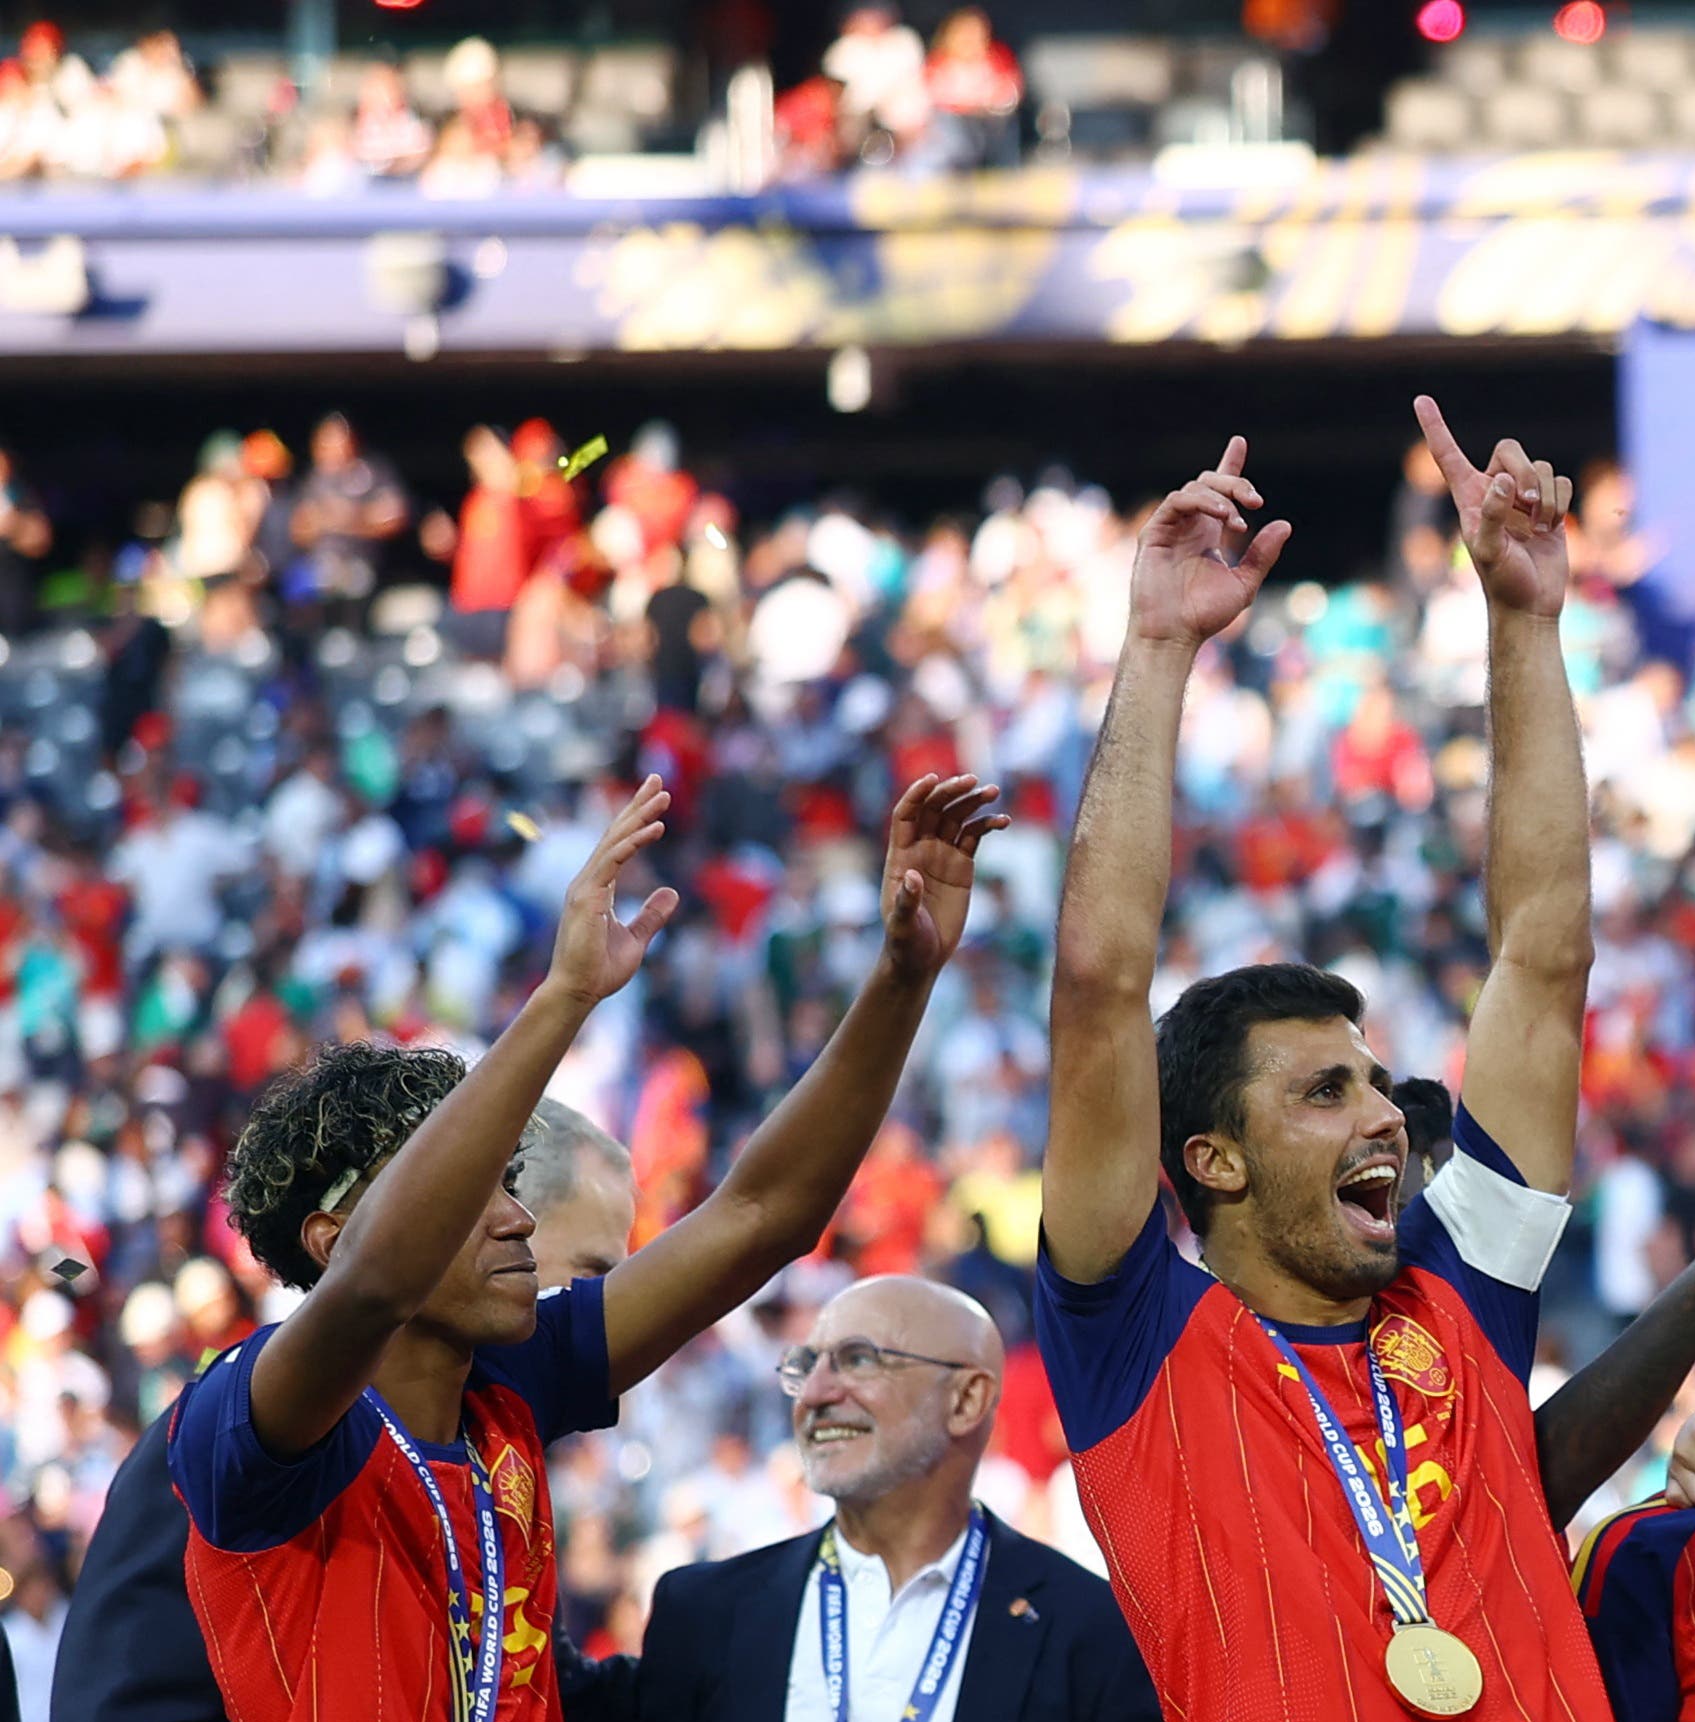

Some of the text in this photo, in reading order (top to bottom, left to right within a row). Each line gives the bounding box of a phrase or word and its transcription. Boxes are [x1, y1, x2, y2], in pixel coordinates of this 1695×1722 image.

[1370, 1364, 1387, 1392] CUP
[1377, 1391, 1397, 1448] 2026
[1332, 1442, 1357, 1476] CUP
[1348, 1476, 1384, 1537] 2026
[482, 1510, 498, 1573] 2026
[490, 1575, 499, 1613] CUP
[953, 1559, 977, 1610] WORLD
[481, 1619, 499, 1684] WORLD
[827, 1618, 843, 1673] WORLD
[942, 1608, 962, 1641] CUP
[919, 1638, 952, 1695] 2026
